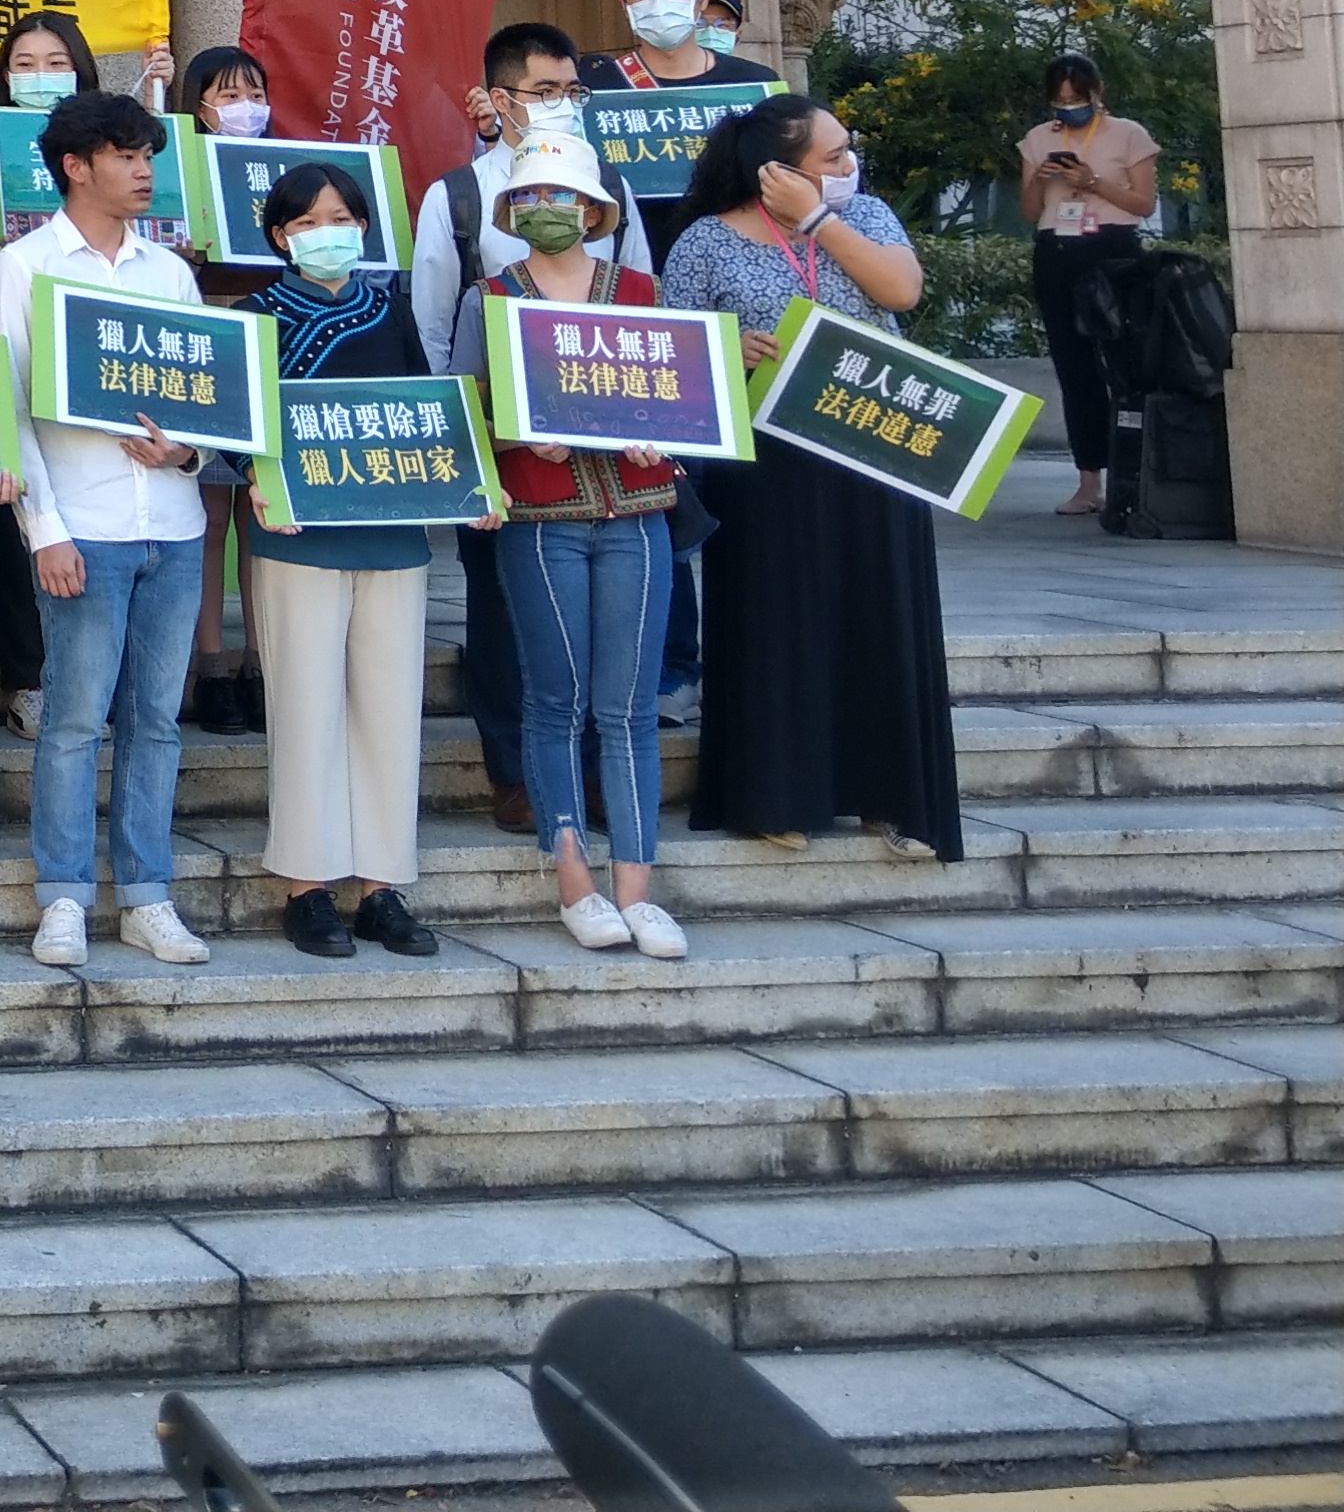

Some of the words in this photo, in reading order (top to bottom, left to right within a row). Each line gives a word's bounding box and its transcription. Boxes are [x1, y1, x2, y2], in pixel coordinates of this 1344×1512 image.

[96, 316, 216, 366] 獵人無罪
[552, 322, 678, 364] 獵人無罪
[98, 356, 217, 407] 法律違憲
[557, 359, 681, 403] 法律違憲
[832, 347, 964, 423] 獵人無罪
[290, 400, 450, 444] 獵槍要除罪
[813, 383, 944, 460] 法律違憲
[298, 447, 461, 488] 獵人要回家
